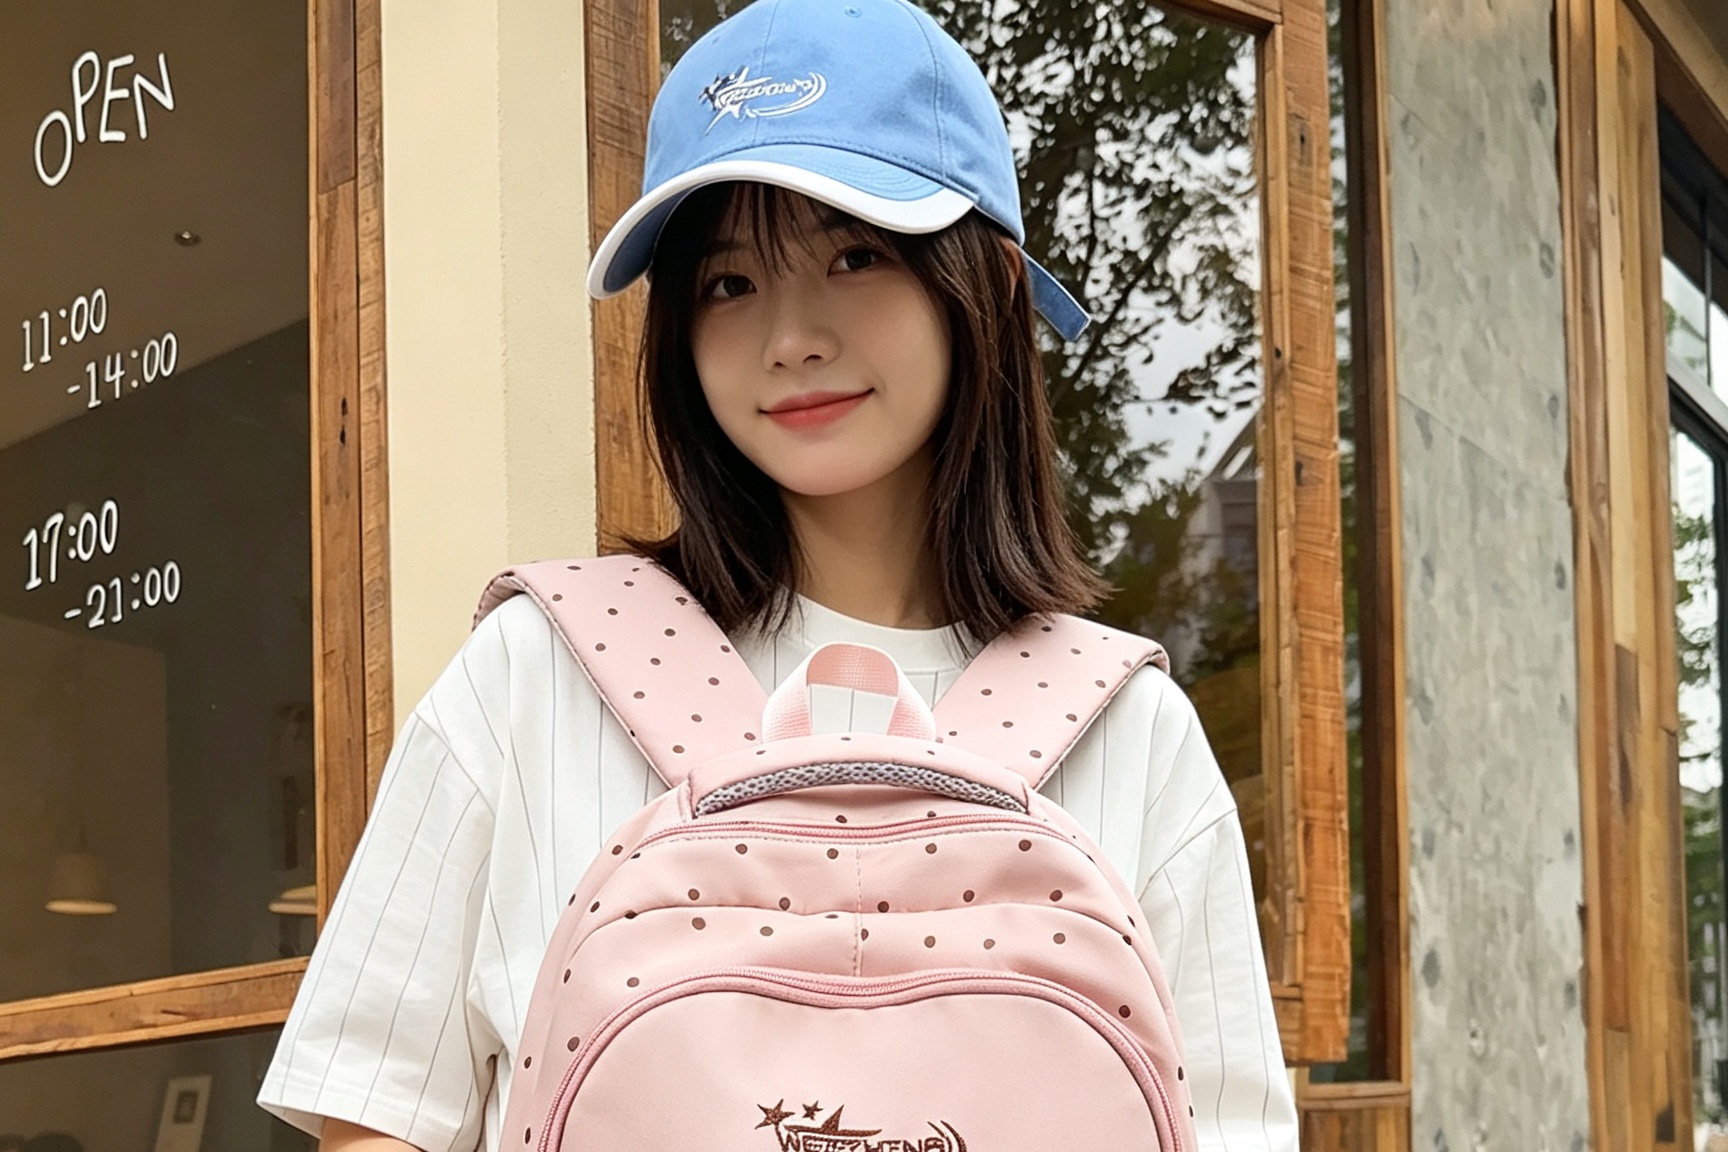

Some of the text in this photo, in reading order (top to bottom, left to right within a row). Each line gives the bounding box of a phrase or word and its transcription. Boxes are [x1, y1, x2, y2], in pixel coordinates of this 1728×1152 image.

[34, 51, 174, 186] OPEN
[21, 288, 109, 371] 11:00
[22, 500, 119, 591] 17:00
